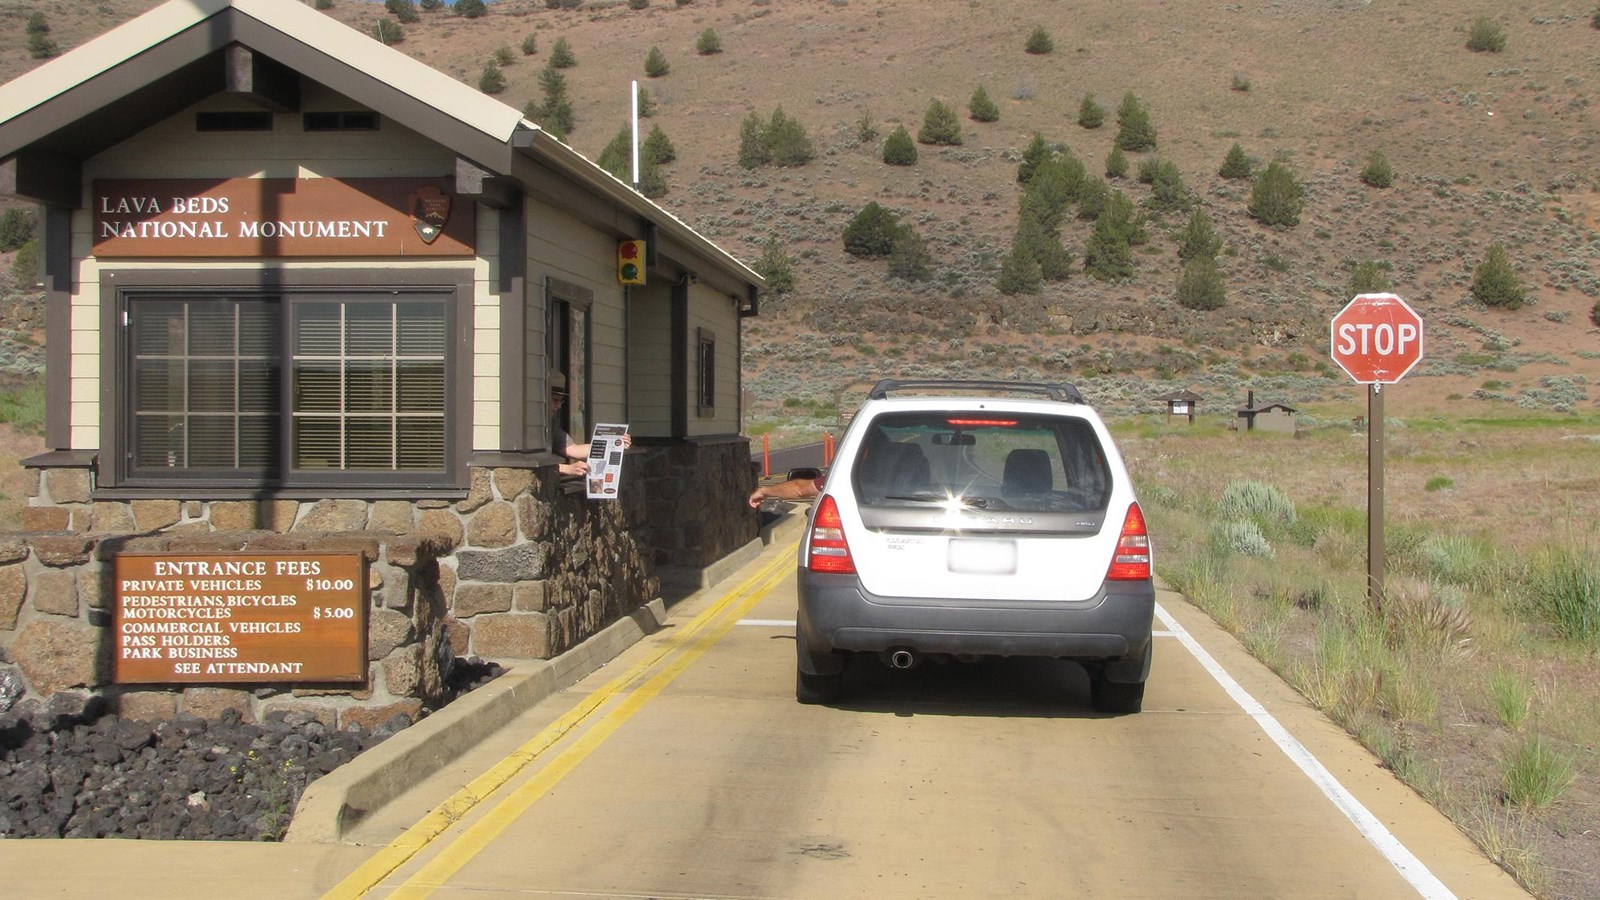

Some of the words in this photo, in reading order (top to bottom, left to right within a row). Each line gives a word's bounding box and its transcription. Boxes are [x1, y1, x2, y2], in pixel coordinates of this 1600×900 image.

[101, 197, 161, 213] LAVA
[172, 197, 229, 214] BEDS
[101, 220, 228, 238] NATIONAL
[238, 220, 389, 238] MONUMENT
[1337, 323, 1417, 356] STOP
[154, 561, 267, 576] ENTRANCE
[275, 561, 321, 576] FEES
[122, 580, 185, 591] PRIVATE
[190, 580, 262, 591] VEHICLES
[306, 578, 354, 592] $10.00
[122, 607, 232, 619] MOTORCYCLES
[122, 622, 223, 634] COMMERCIAL
[229, 622, 301, 633] VEHICLES
[122, 635, 156, 646] PASS
[162, 635, 231, 646] HOLDERS
[122, 647, 163, 659] PARK
[168, 647, 238, 659] BUSINESS
[174, 662, 201, 674] SEE
[206, 662, 304, 674] ATTENDANT
